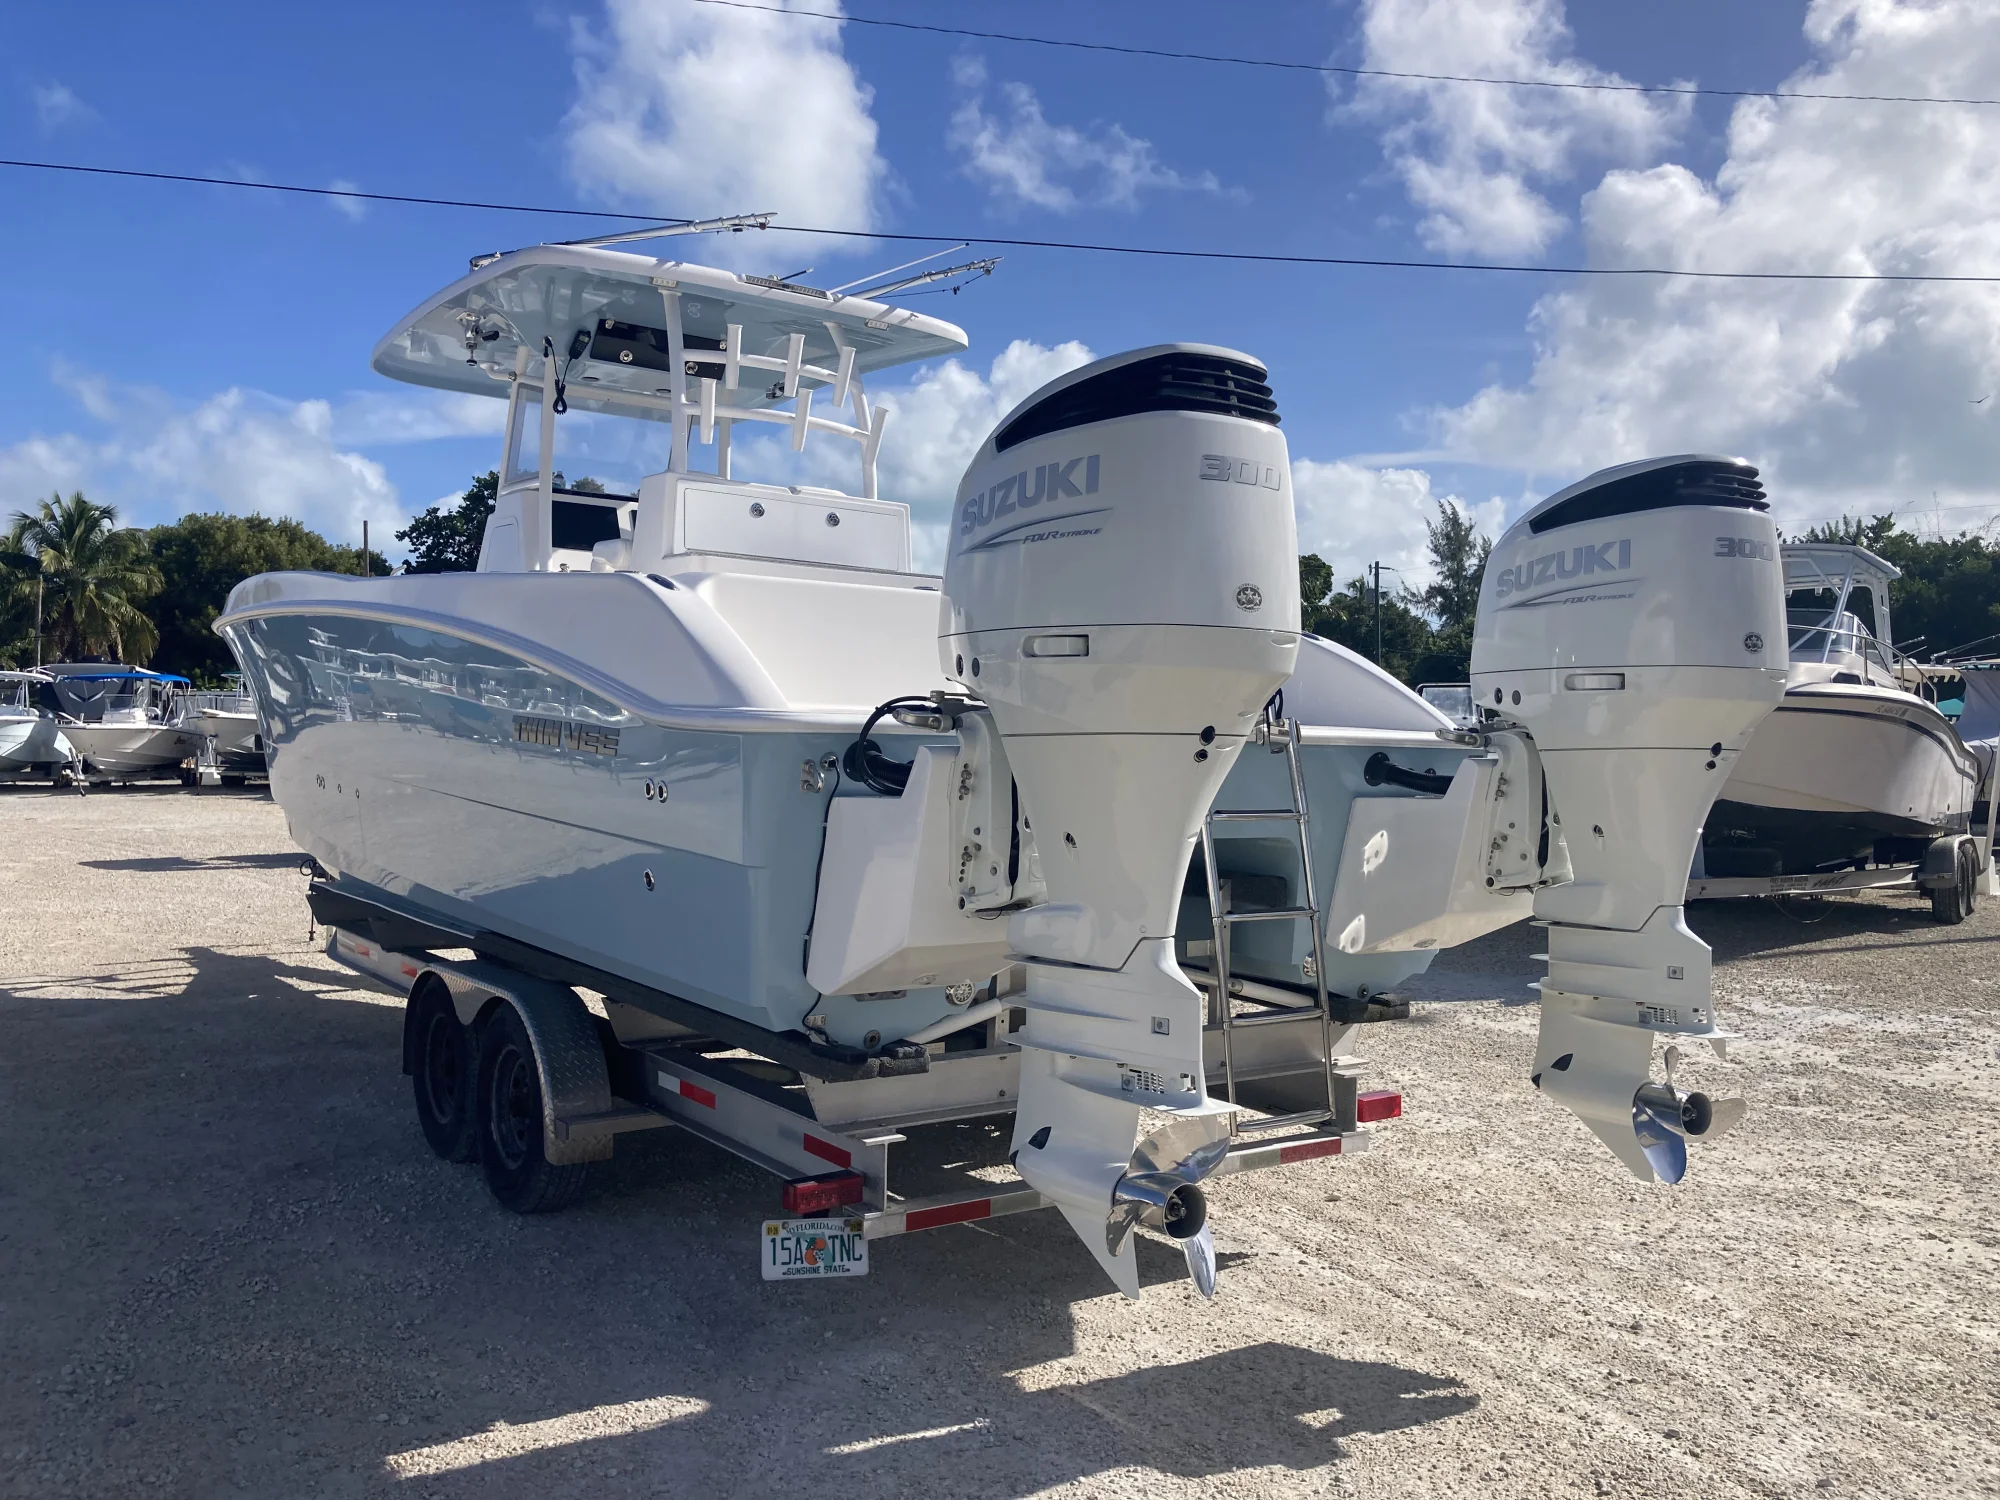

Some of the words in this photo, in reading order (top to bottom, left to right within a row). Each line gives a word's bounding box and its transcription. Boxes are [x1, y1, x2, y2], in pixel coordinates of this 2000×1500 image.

[1199, 454, 1281, 492] 300
[961, 454, 1101, 536] SUZUKI
[1713, 537, 1773, 562] 300
[1495, 539, 1631, 598] SUZUKI
[828, 1233, 863, 1263] TNC
[786, 1266, 821, 1276] SUNSHINE
[824, 1265, 847, 1274] STATE
